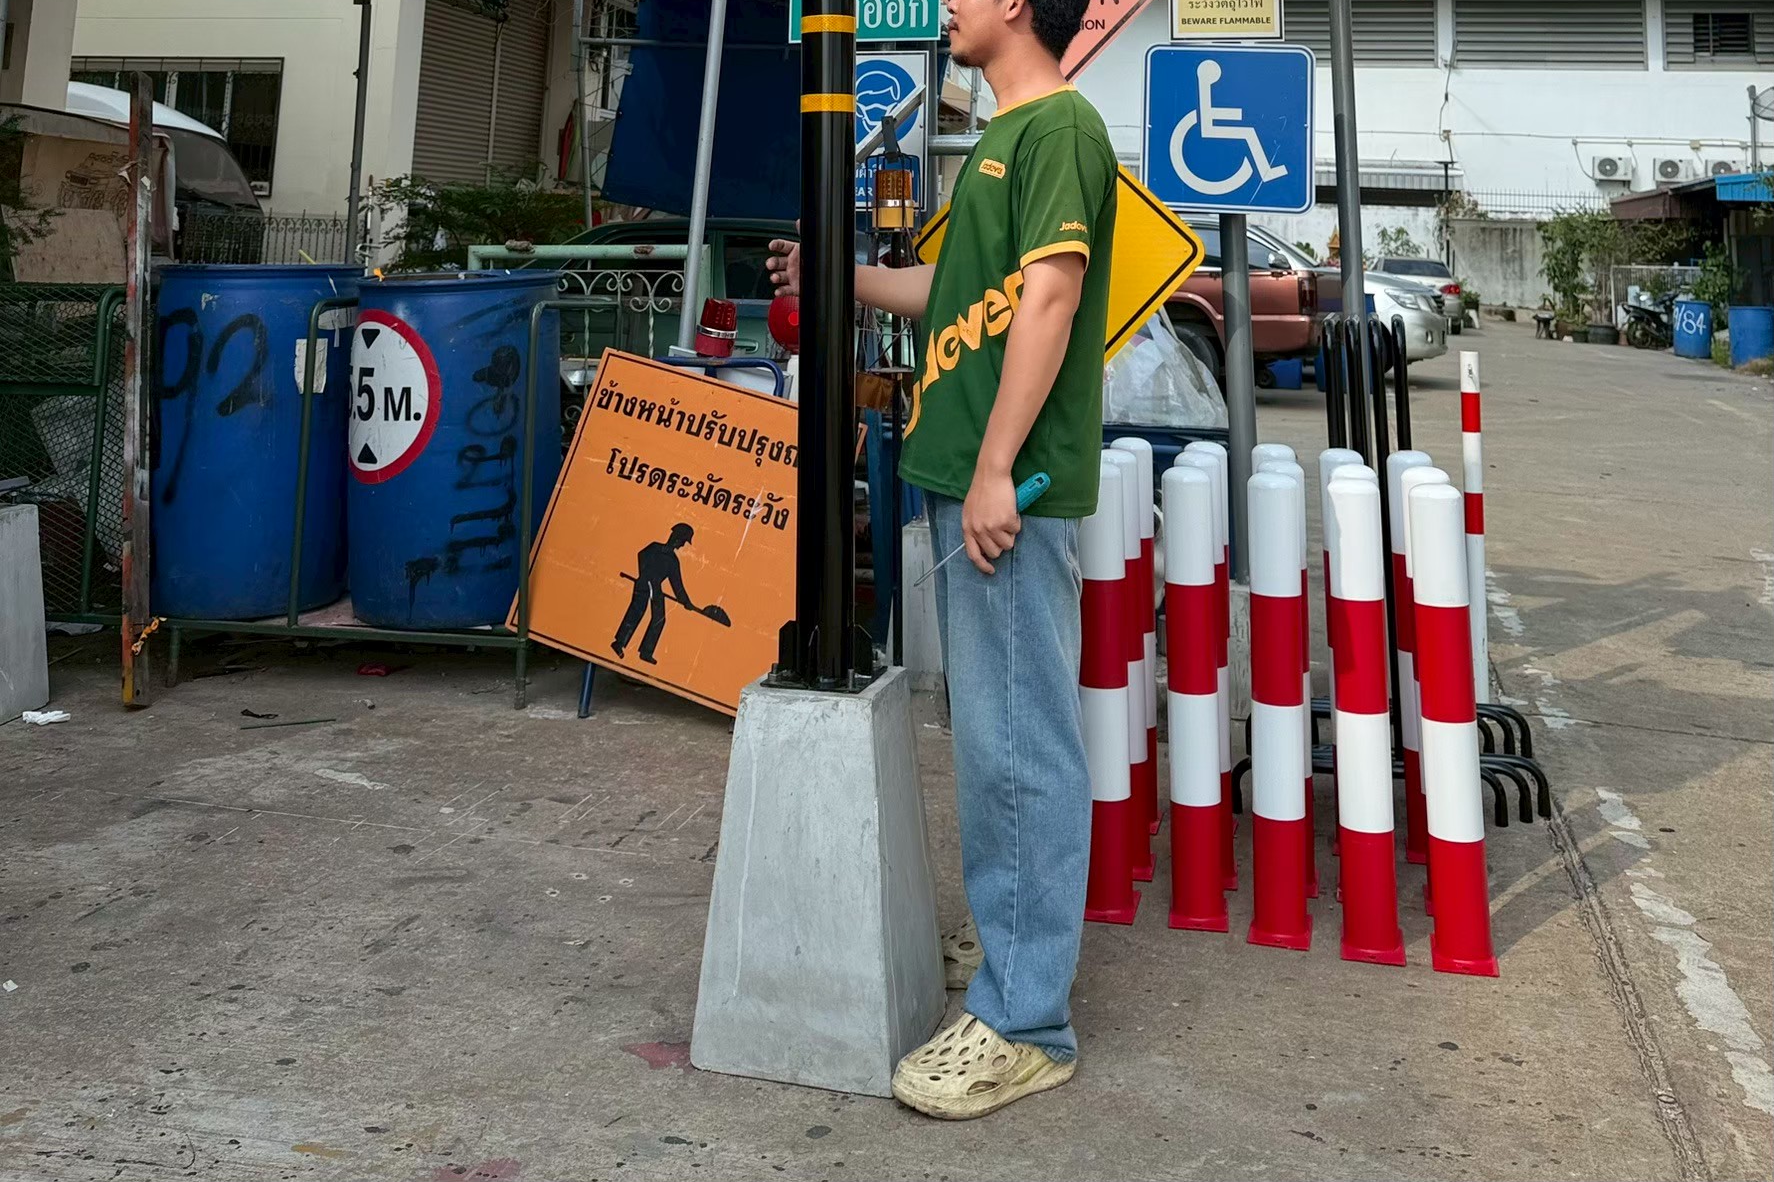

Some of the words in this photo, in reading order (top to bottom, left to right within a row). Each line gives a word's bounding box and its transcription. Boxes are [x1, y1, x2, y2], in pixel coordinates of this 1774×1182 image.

[1219, 16, 1272, 24] FLAMMABLE
[383, 386, 422, 422] M.
[596, 379, 799, 469] ข้างหน้าปรับปรุงถ
[605, 447, 790, 532] โปรดระมัดระวัง
